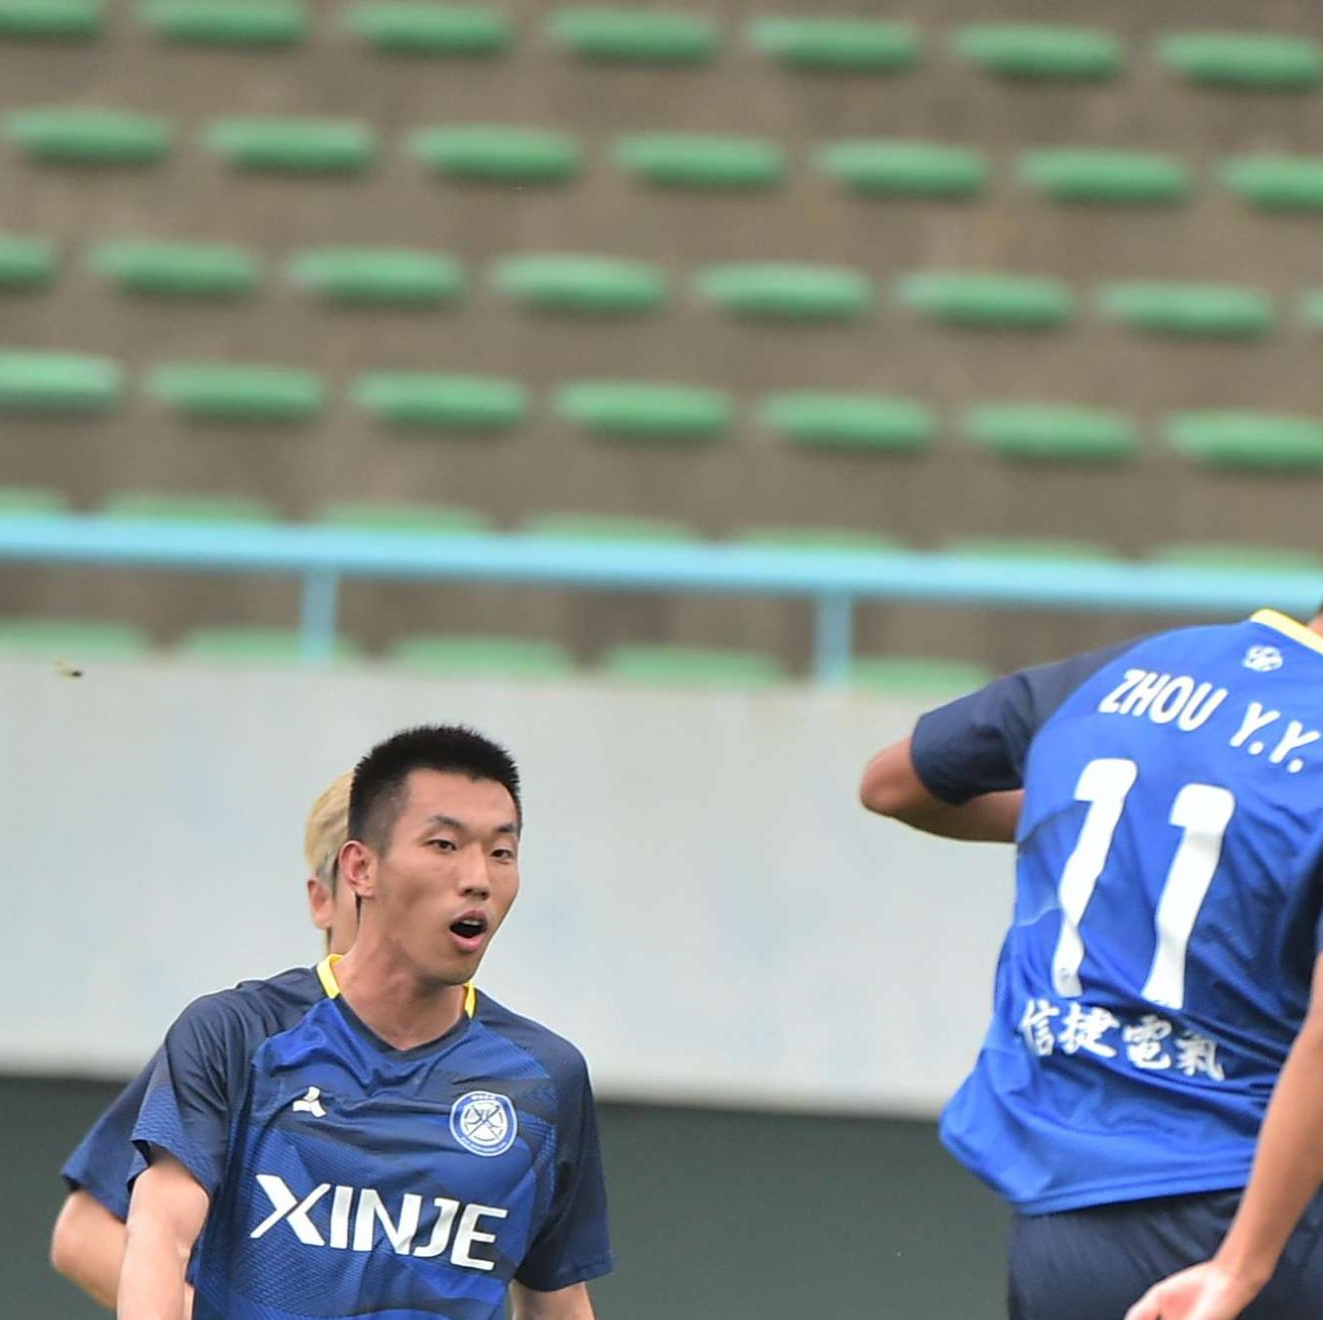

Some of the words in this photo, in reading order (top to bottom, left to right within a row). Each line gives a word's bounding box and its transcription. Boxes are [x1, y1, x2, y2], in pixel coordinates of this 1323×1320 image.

[1098, 668, 1229, 732] ZHOU
[1229, 702, 1322, 773] Y.Y.
[1050, 757, 1236, 1010] 11
[249, 1173, 509, 1271] XINJE
